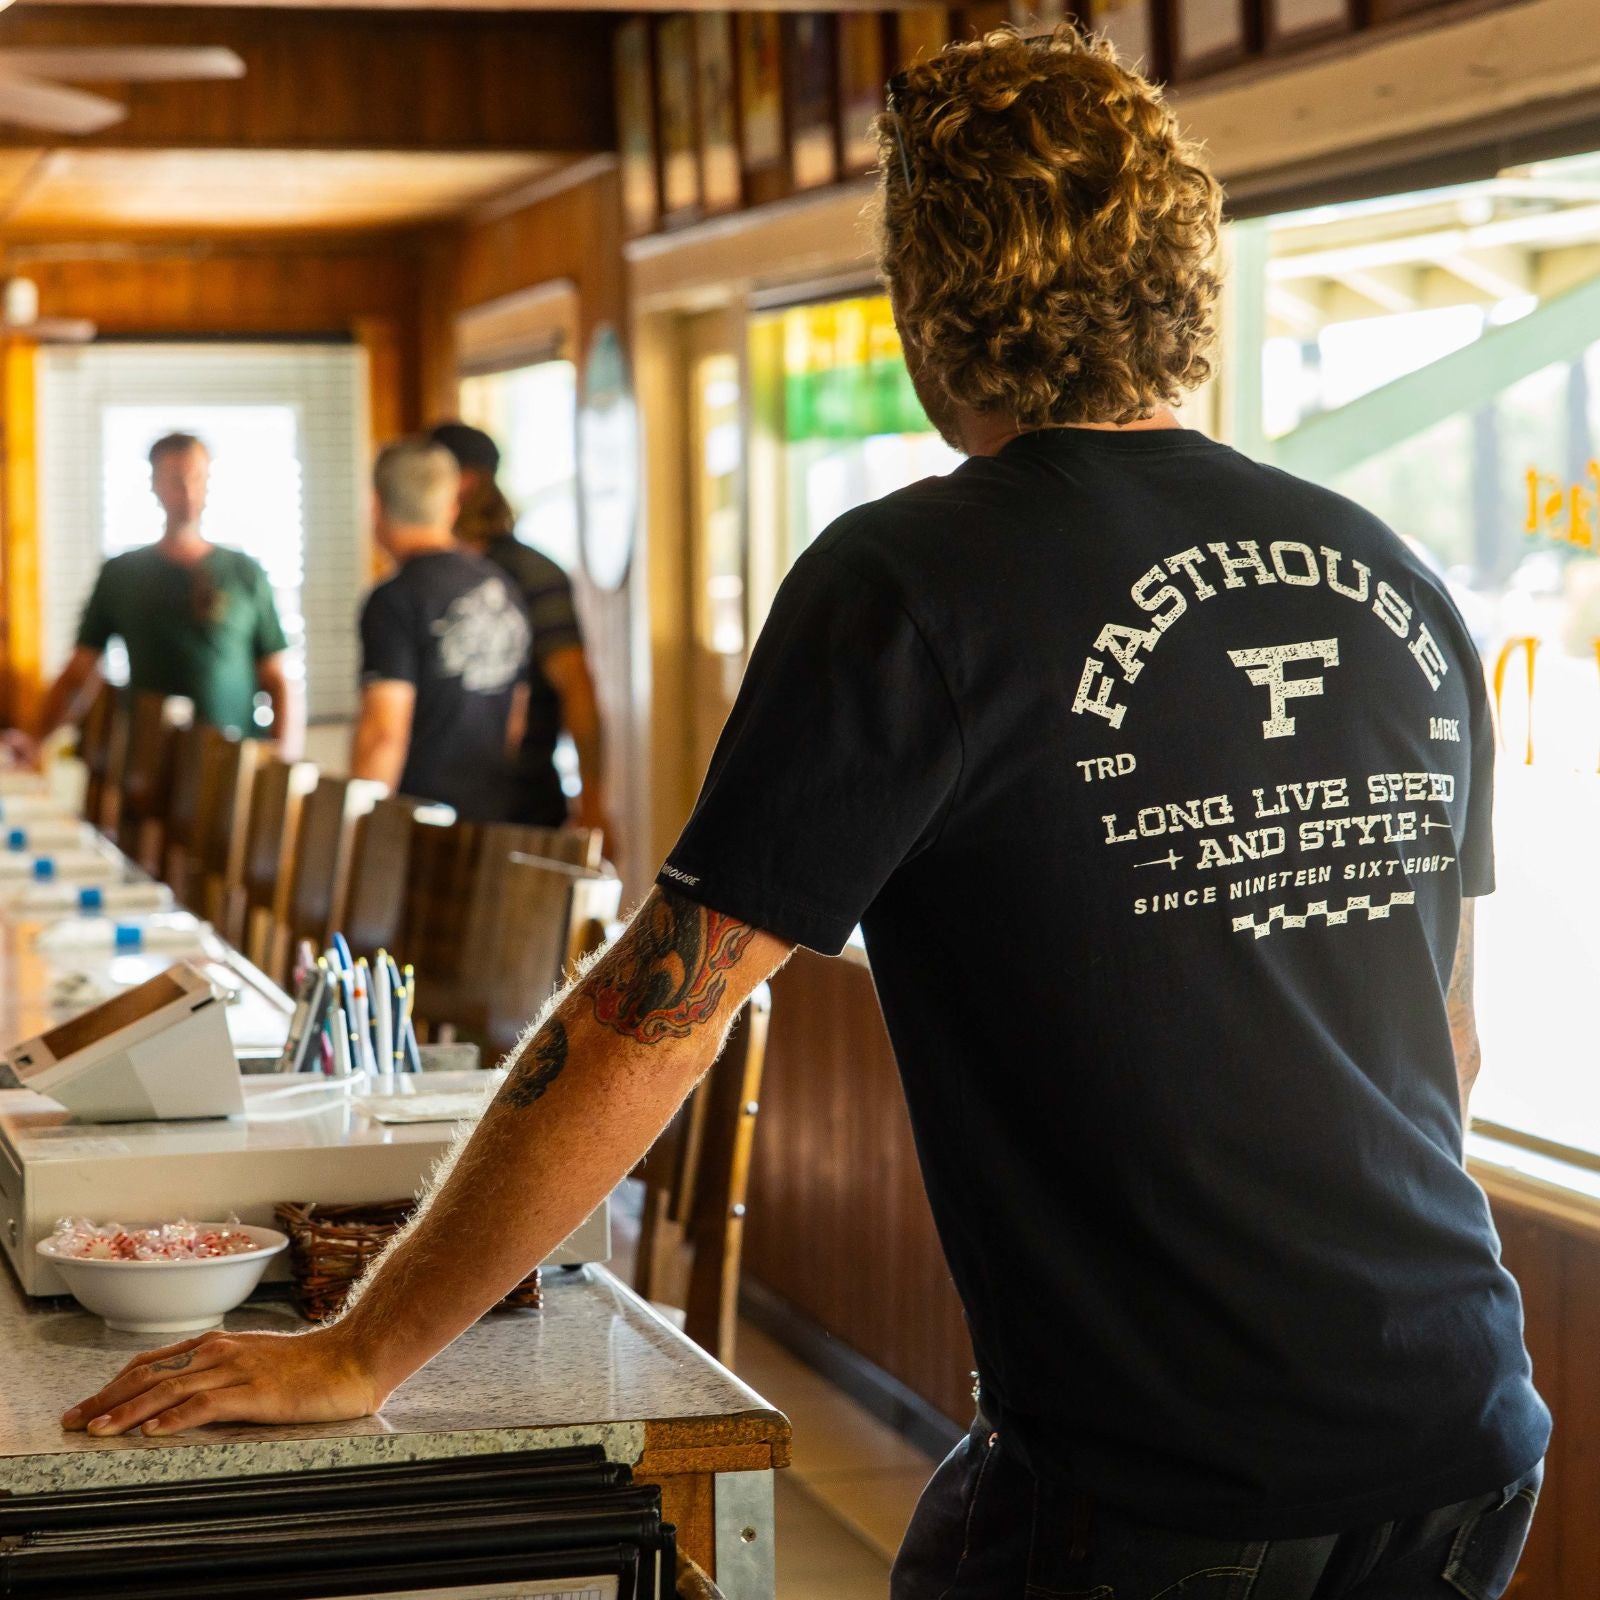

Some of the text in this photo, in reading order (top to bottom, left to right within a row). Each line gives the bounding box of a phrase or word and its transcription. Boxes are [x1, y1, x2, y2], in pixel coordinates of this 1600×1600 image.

[1071, 540, 1448, 730] FASTHOUSE
[1076, 717, 1461, 782] TRD MRK
[1102, 772, 1455, 845] LONG LIVE SPEED
[1197, 811, 1418, 870] AND STYLE
[1134, 886, 1218, 915] SINCE
[1230, 865, 1333, 900] NINETEEN
[1406, 854, 1456, 874] EIGHT
